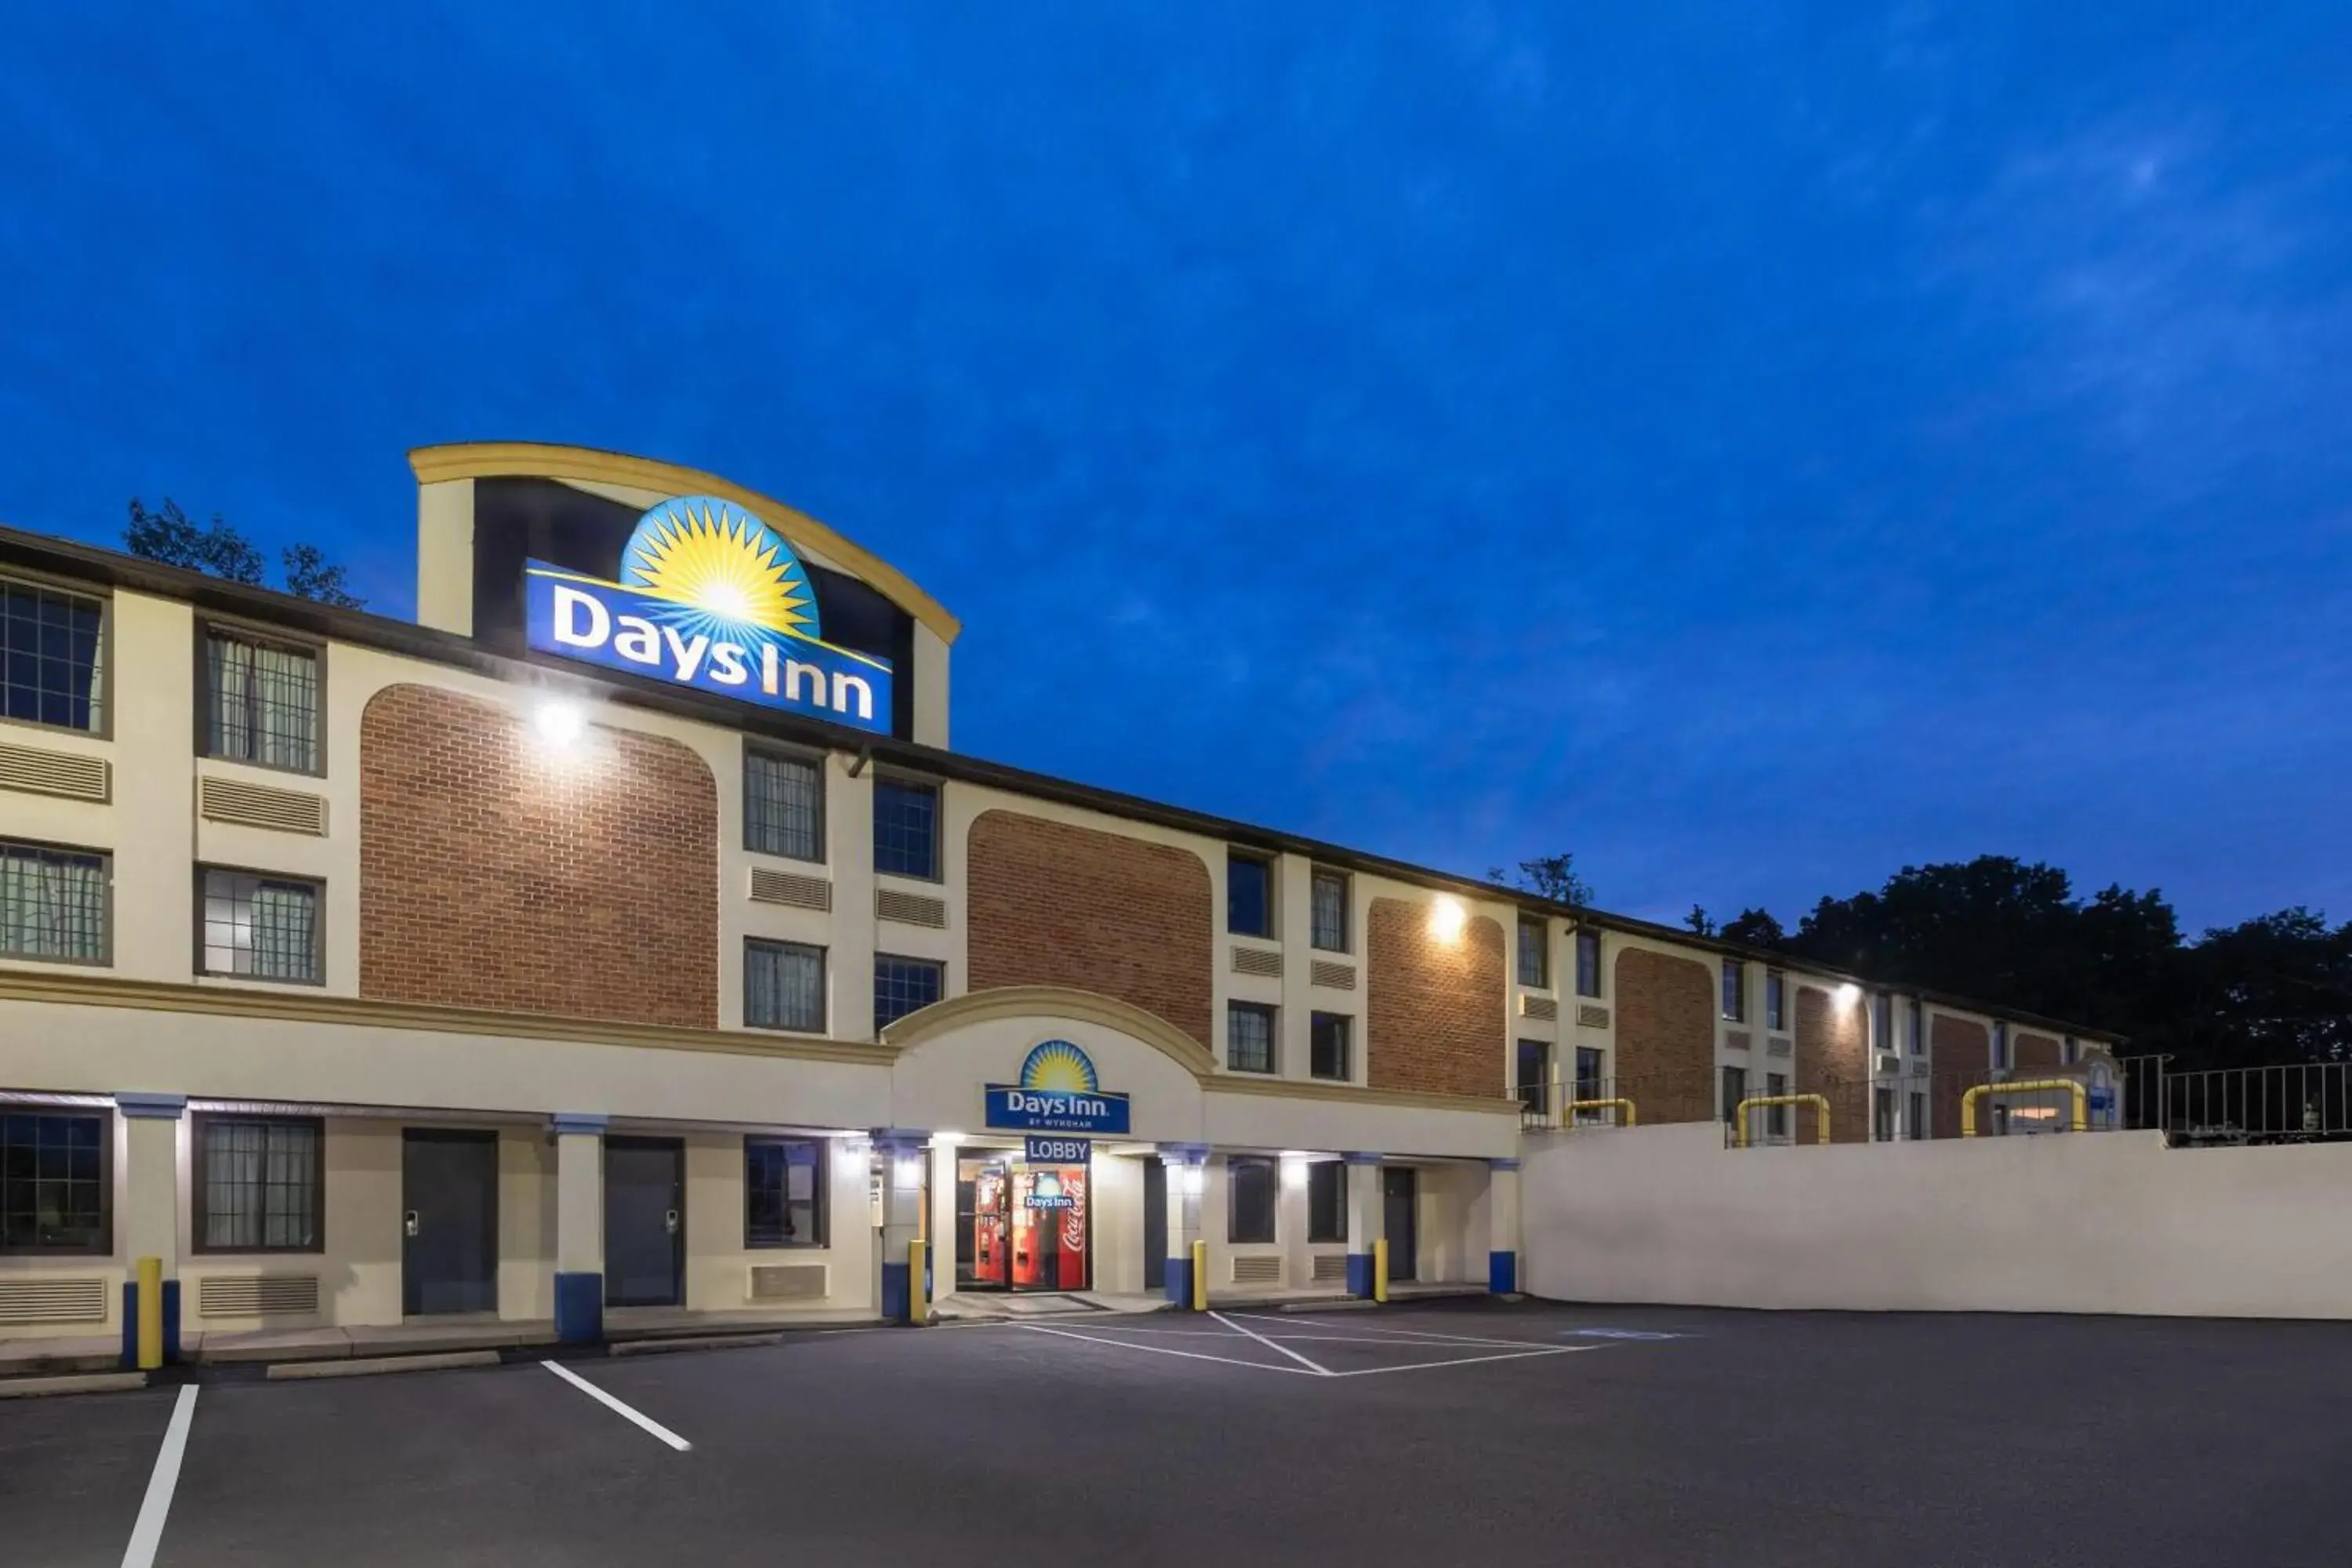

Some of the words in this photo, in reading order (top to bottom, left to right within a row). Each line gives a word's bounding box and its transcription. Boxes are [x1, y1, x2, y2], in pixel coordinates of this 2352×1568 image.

[554, 585, 746, 684] Days
[762, 643, 873, 720] Inn
[1007, 1092, 1065, 1116] Days
[1069, 1096, 1109, 1116] Inn
[1029, 1141, 1087, 1160] LOBBY
[1026, 1197, 1052, 1207] Days
[1054, 1198, 1072, 1207] Inn
